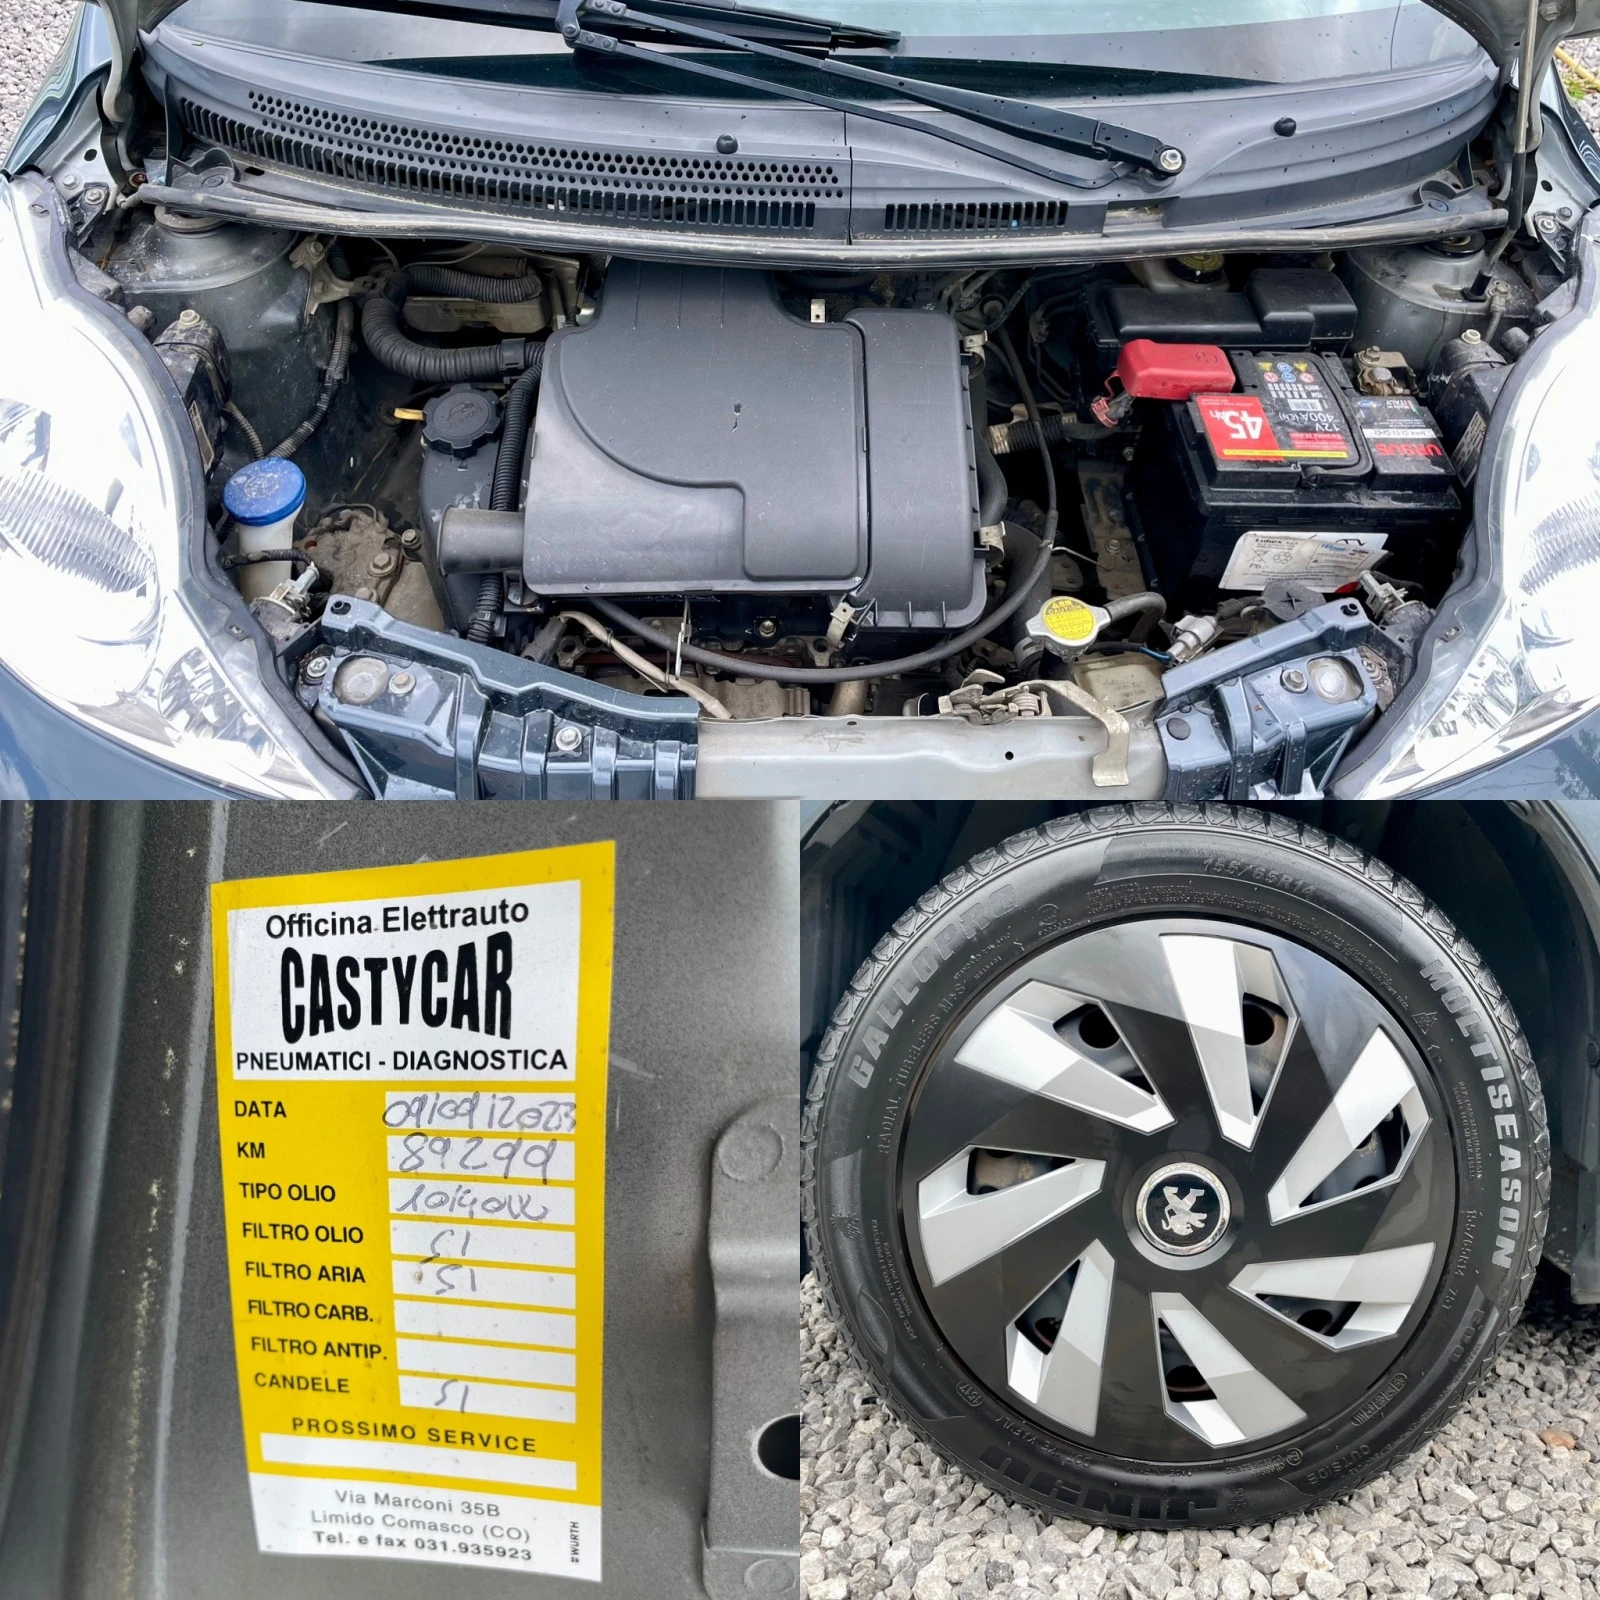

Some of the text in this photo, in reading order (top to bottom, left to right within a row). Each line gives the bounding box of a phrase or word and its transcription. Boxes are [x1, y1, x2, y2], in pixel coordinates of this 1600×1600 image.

[1315, 422, 1340, 432] 12V
[1374, 442, 1443, 457] URSUS
[1047, 604, 1082, 615] CAUTION
[1202, 855, 1316, 898] 155/65R14
[265, 899, 530, 940] Officina Elettrauto
[280, 930, 513, 1045] CASTYCAR
[849, 883, 1017, 1089] GALLOPRO
[236, 1051, 372, 1071] PNEUMATICI
[392, 1048, 568, 1071] DIAGNOSTICA
[234, 1100, 287, 1118] DATA
[1418, 958, 1523, 1270] MULTISEASON
[236, 1142, 266, 1160] KM
[399, 1132, 557, 1185] 89299
[239, 1181, 336, 1202] TIPO OLIO
[242, 1222, 364, 1244] FILTRO OLIO
[245, 1261, 366, 1283] FILTRO ARIA
[248, 1300, 374, 1323] FILTRO CARB.
[251, 1336, 388, 1361] FILTRO ANTIP.
[254, 1372, 350, 1394] CANDELE
[292, 1417, 537, 1453] PROSSIMO SERVICE
[1064, 1456, 1092, 1469] DOT
[1307, 1443, 1371, 1485] OUTSIDE
[335, 1489, 501, 1517] Via Marconi 35B
[310, 1510, 531, 1544] Limido Comasco (CO)
[312, 1530, 532, 1562] Tel. e fax 031.935923
